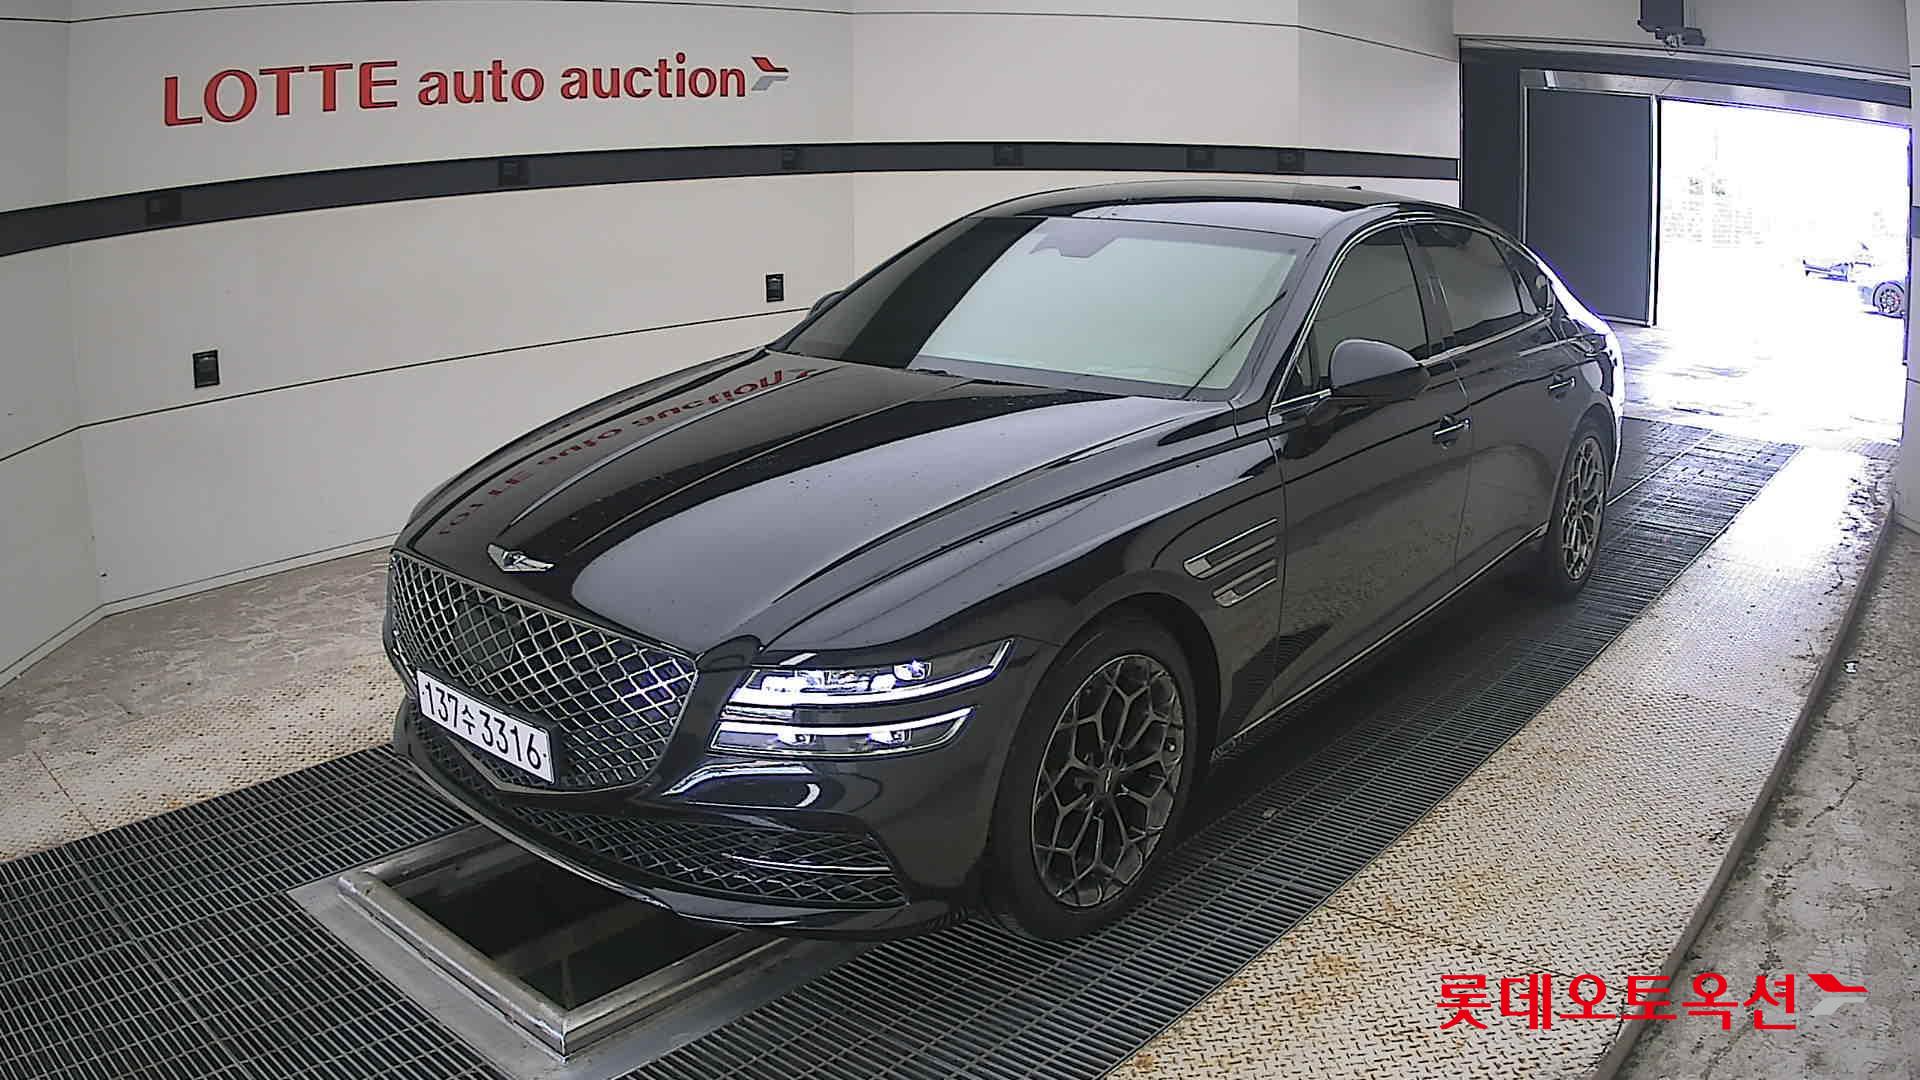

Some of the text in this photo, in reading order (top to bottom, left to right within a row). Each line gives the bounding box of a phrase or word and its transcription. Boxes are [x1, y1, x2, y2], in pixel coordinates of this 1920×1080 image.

[164, 52, 746, 126] LOTTE auto auction
